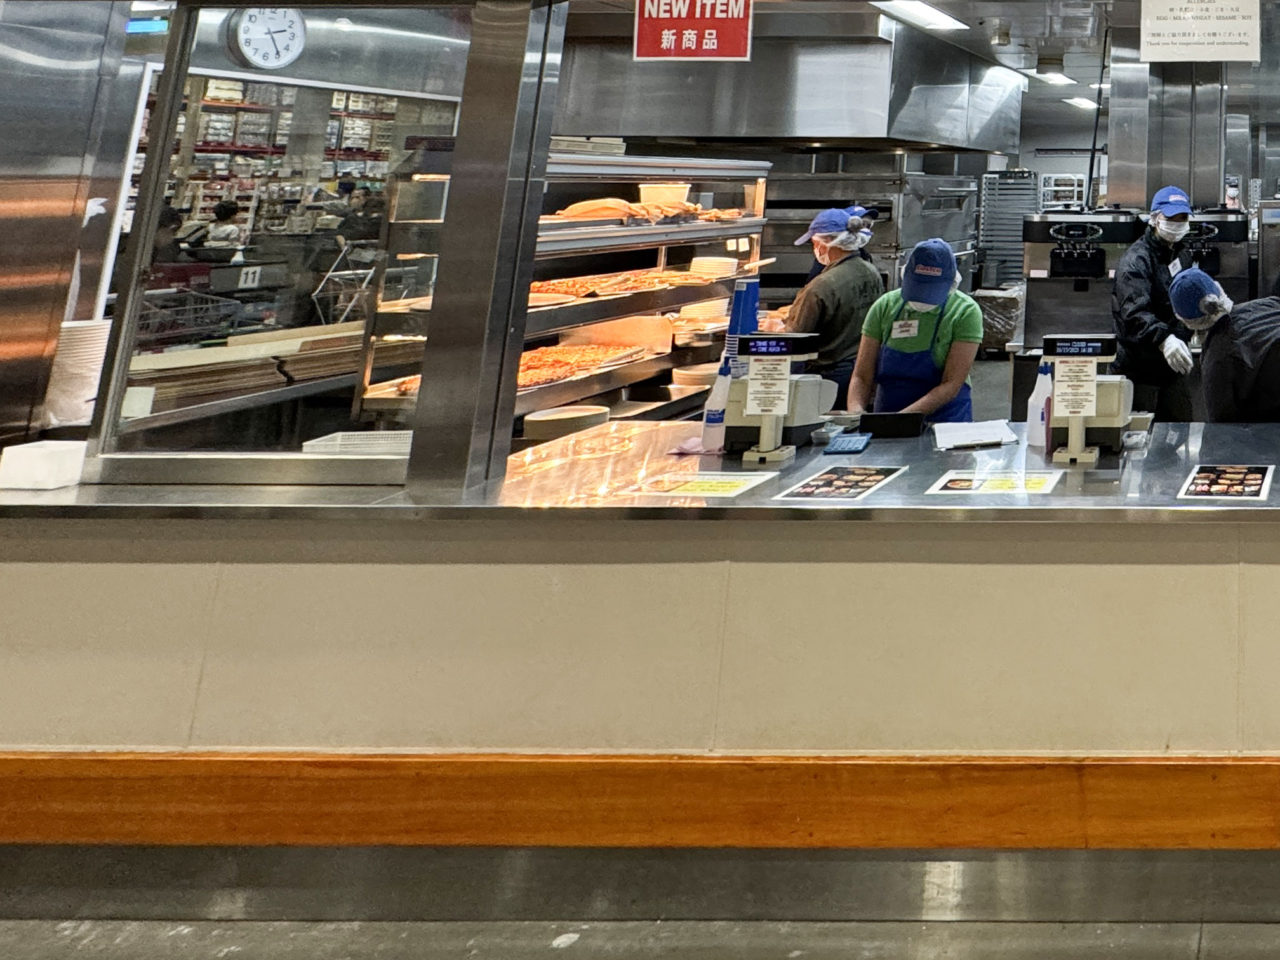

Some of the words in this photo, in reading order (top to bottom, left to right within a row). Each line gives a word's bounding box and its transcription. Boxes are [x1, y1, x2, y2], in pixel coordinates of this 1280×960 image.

[288, 20, 294, 28] 2
[289, 32, 295, 40] 3
[661, 29, 717, 49] 新商品
[252, 48, 259, 56] 7
[263, 52, 269, 61] 6
[242, 269, 258, 285] 11
